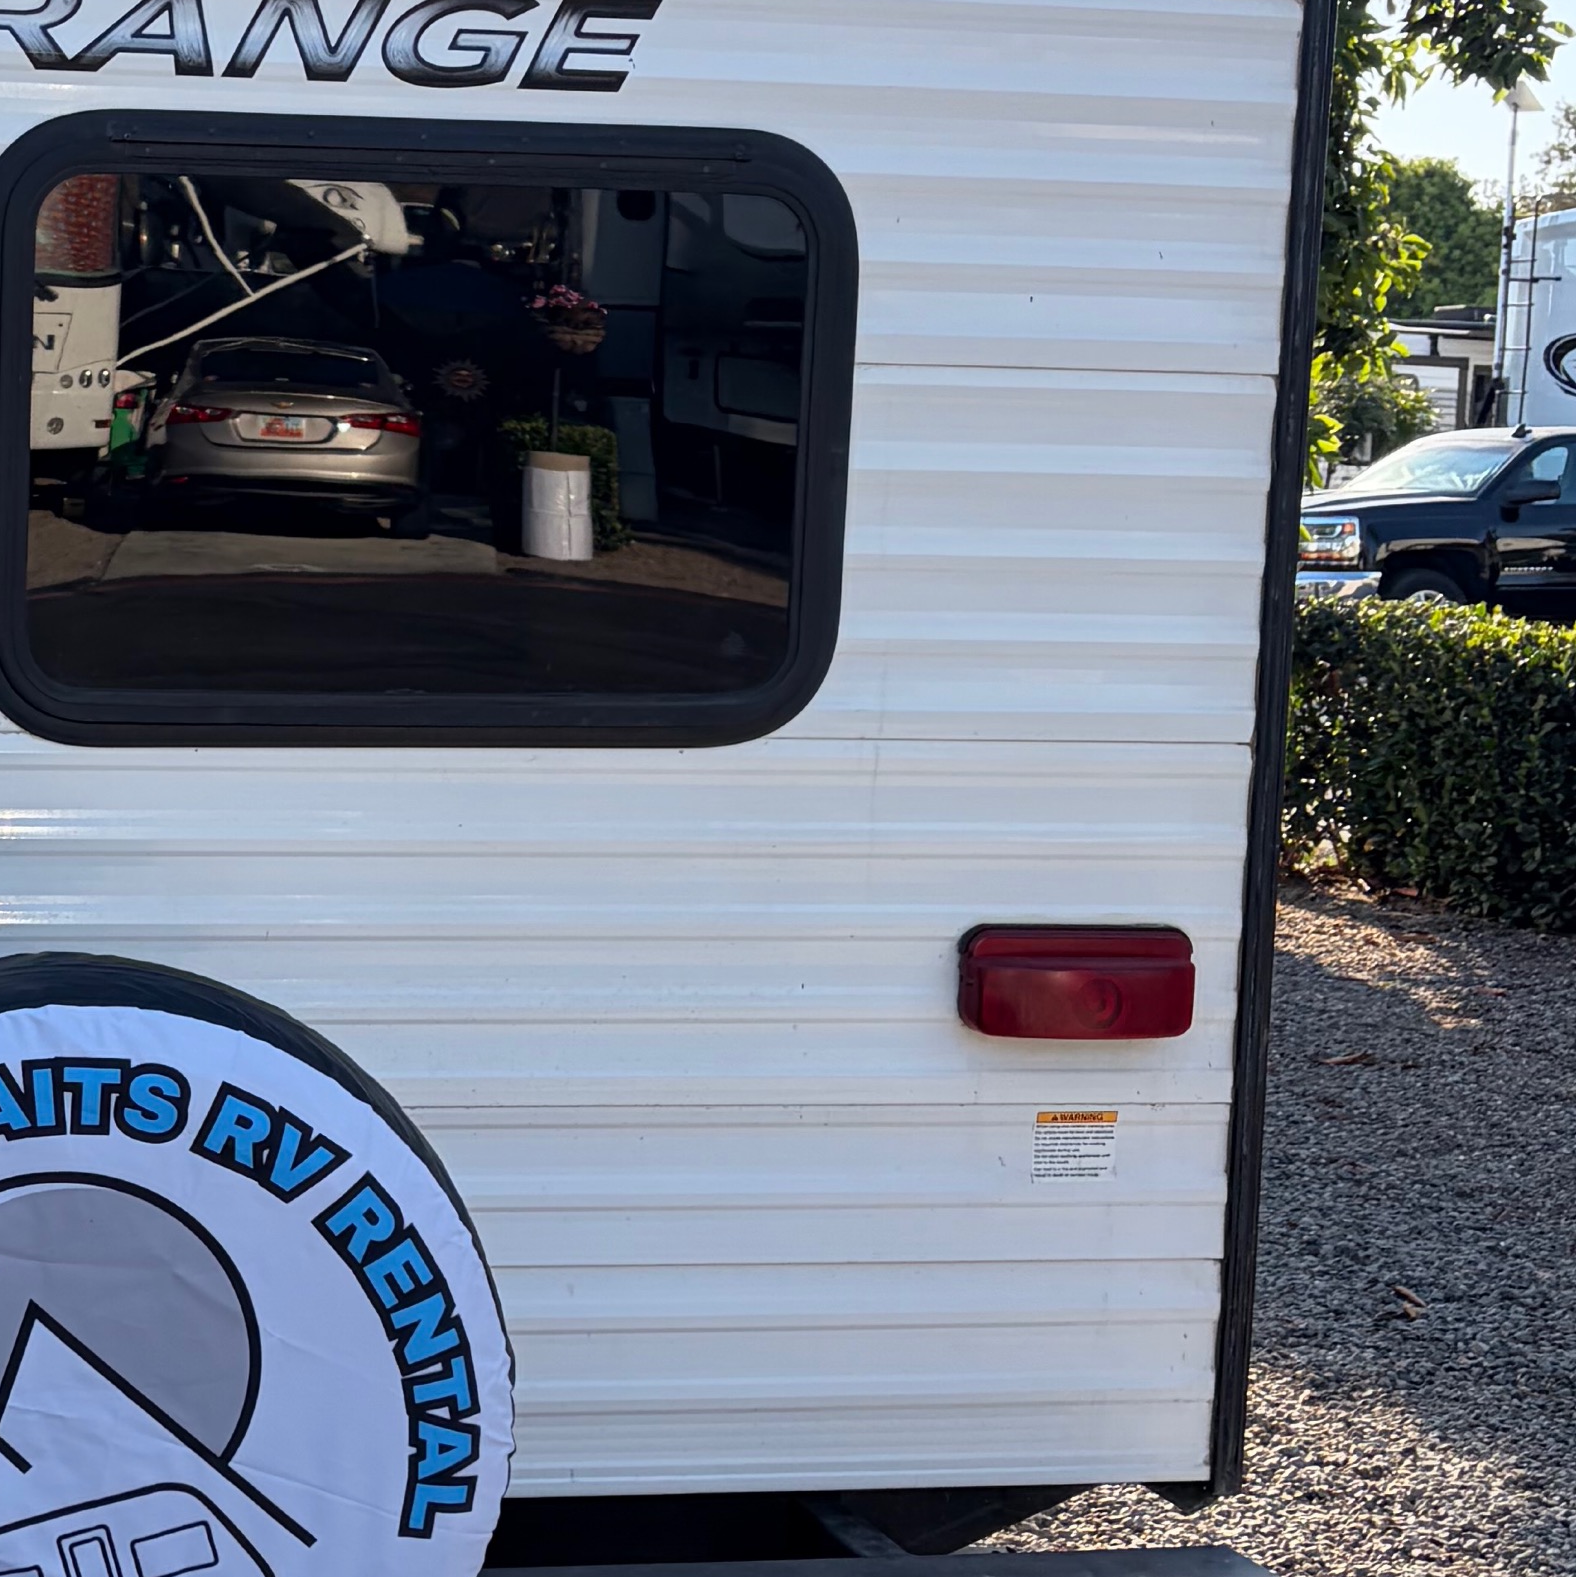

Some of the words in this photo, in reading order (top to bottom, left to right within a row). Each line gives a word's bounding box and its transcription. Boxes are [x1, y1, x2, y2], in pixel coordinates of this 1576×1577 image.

[1059, 1113, 1104, 1122] WARNING
[190, 1080, 352, 1203] RV
[311, 1171, 482, 1540] RENTAL
